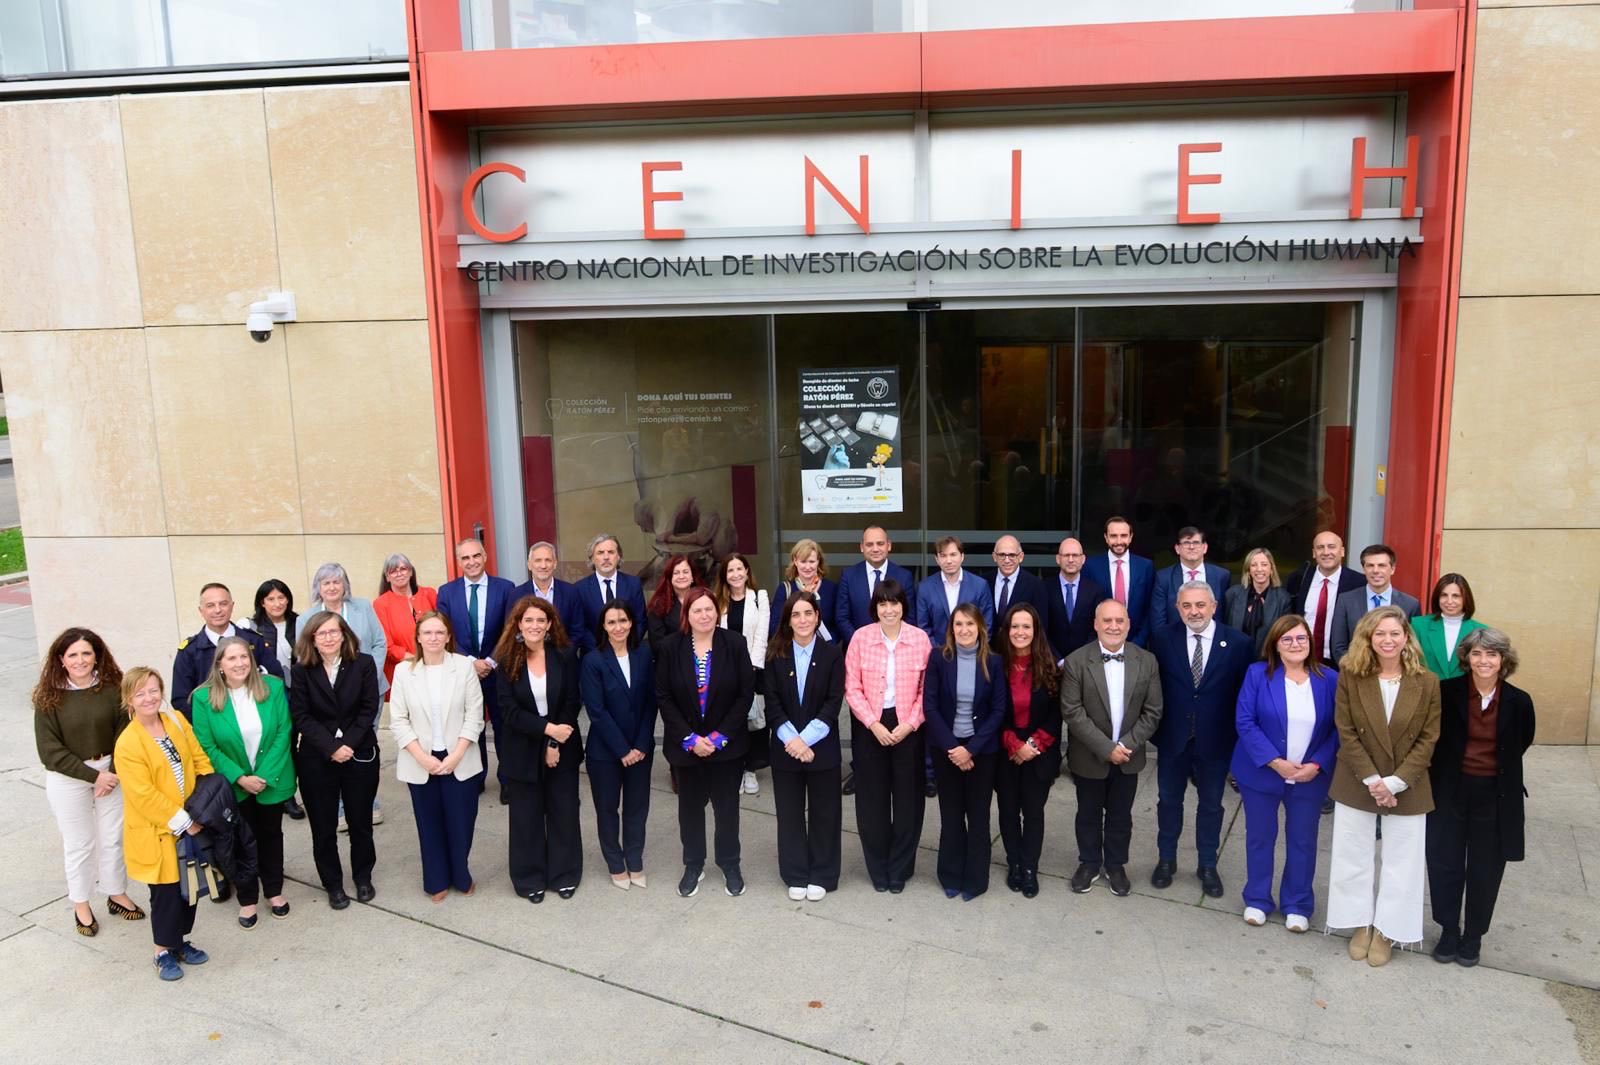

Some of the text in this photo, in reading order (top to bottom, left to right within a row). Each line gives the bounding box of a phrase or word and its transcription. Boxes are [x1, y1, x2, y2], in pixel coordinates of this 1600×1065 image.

[466, 235, 1417, 282] CENTRO NACIONAL DE INVESTIGACIÓN SOBRE LA EVOLUCIÓN HUMANA
[803, 384, 845, 392] COLECCIÓN
[566, 397, 608, 405] COLECCIÓN
[637, 392, 733, 402] DONA AQUÍ TUS DIENTES
[803, 392, 854, 401] RATÓN PÉREZ
[566, 405, 616, 414] RATÓN PÉREZ
[637, 414, 722, 425] ratonperez@cenieh.es
